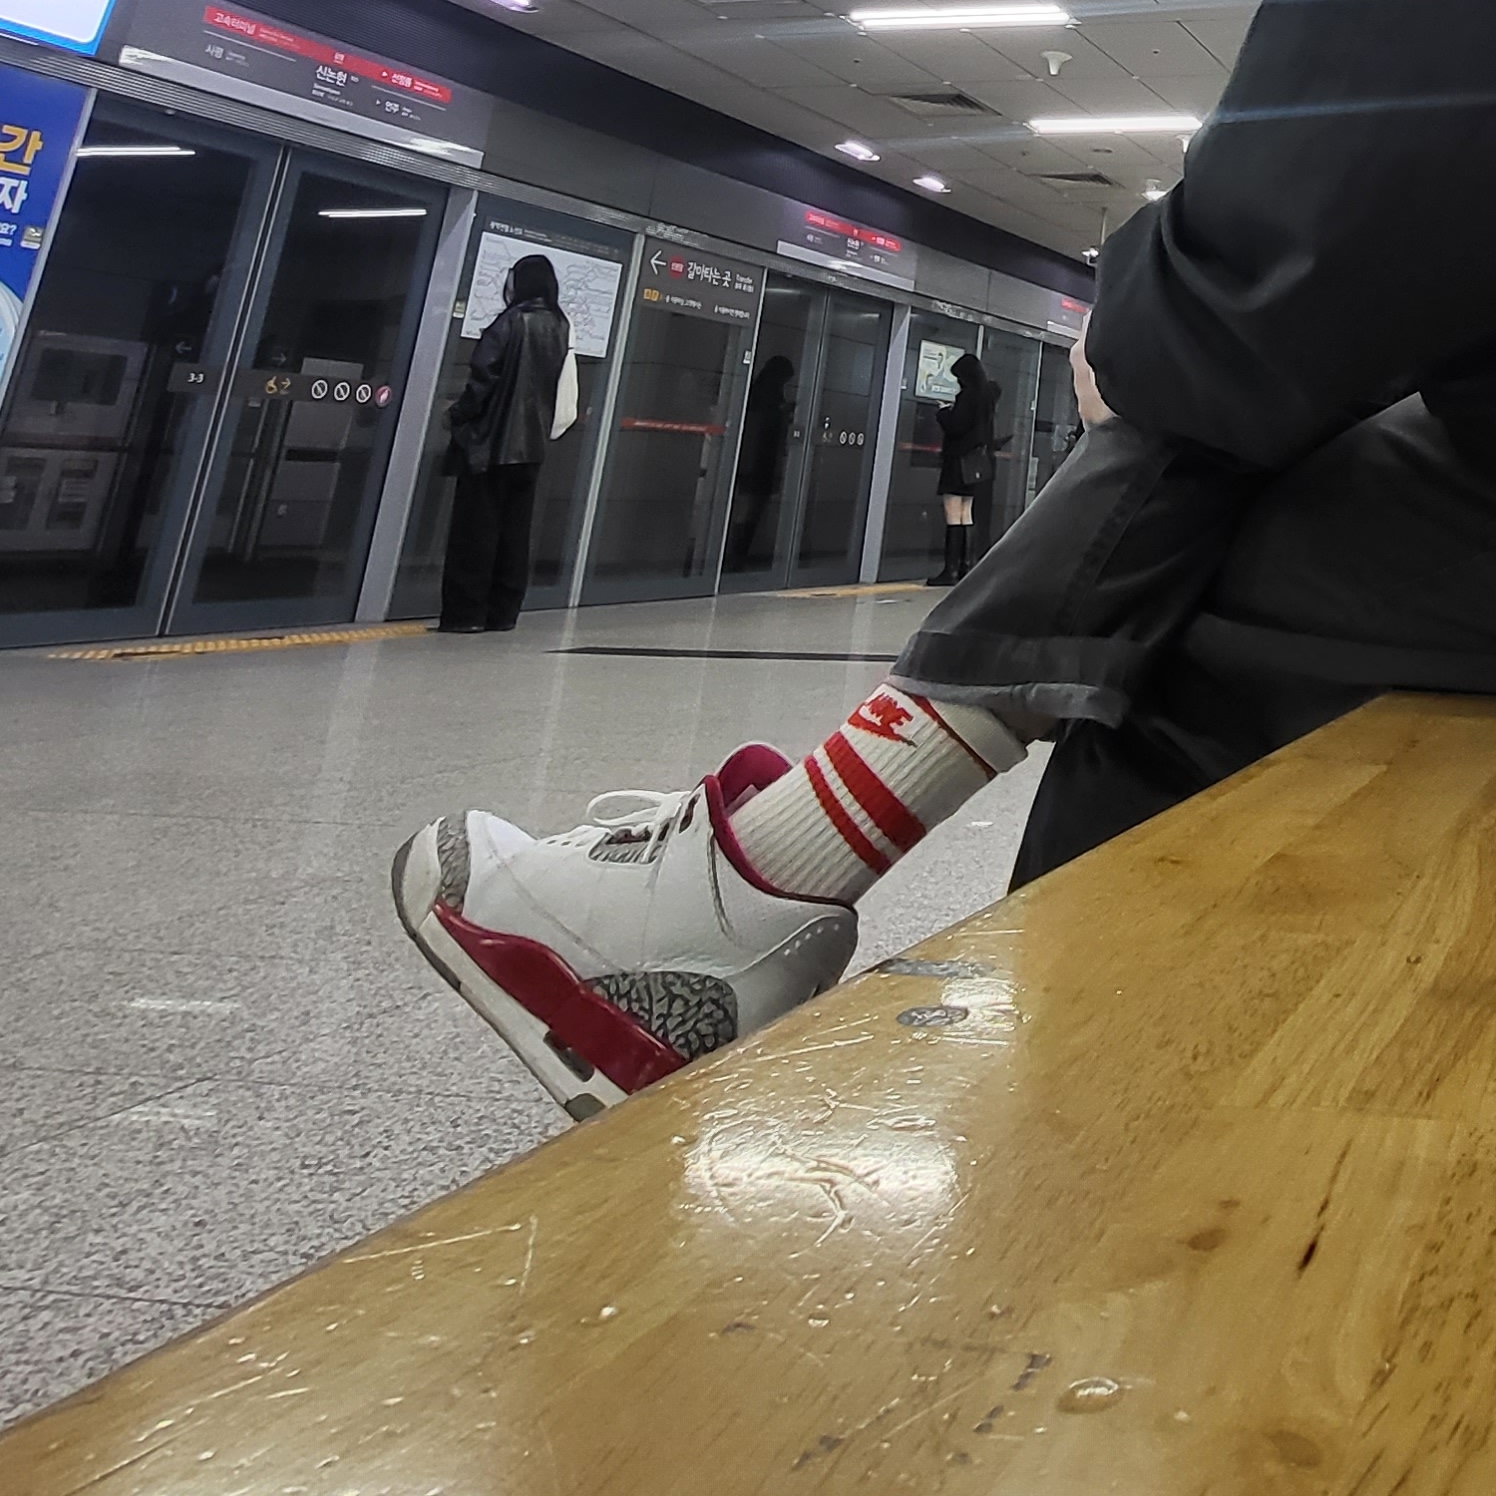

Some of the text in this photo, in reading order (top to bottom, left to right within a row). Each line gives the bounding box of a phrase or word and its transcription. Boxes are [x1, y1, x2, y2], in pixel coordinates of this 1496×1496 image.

[316, 65, 348, 87] 신논현
[687, 261, 721, 286] 갈아타는
[722, 271, 732, 287] 곳
